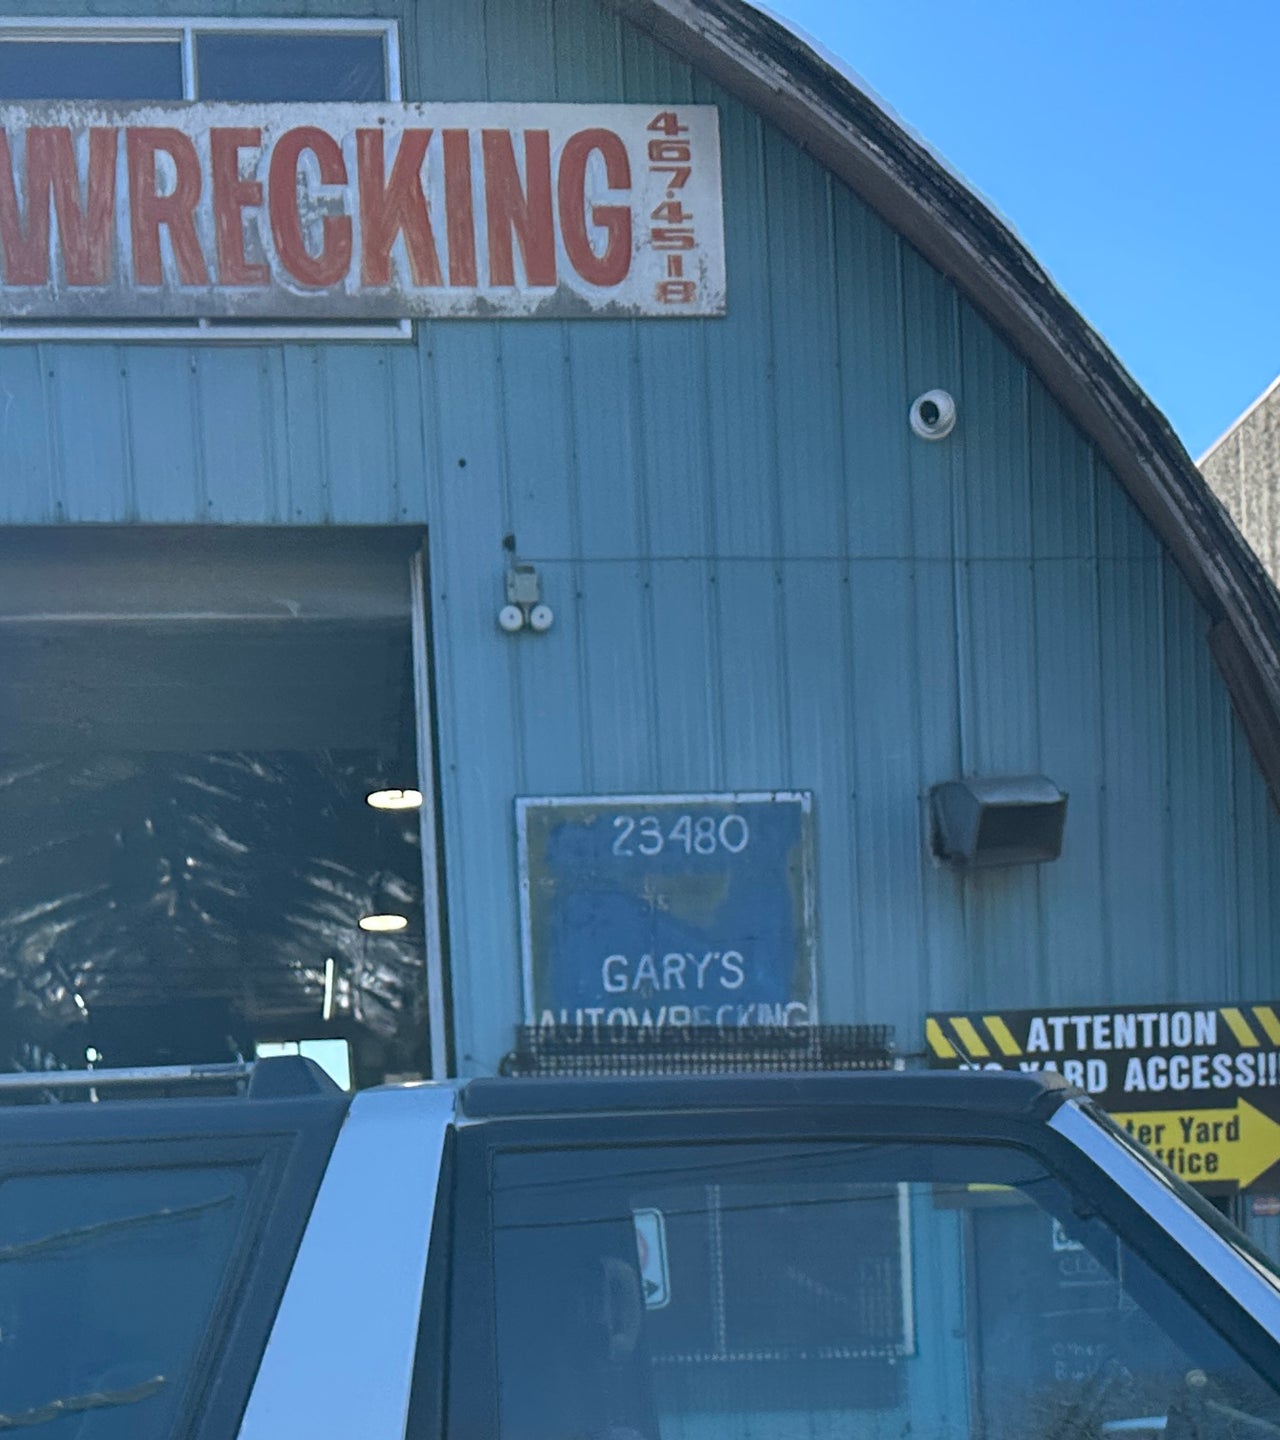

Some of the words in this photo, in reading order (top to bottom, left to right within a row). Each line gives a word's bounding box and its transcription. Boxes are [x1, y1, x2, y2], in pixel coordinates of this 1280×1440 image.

[612, 815, 750, 856] 23480
[601, 951, 745, 993] GARY'S
[1026, 1010, 1218, 1053] ATTENTION
[1178, 1114, 1240, 1144] Yard
